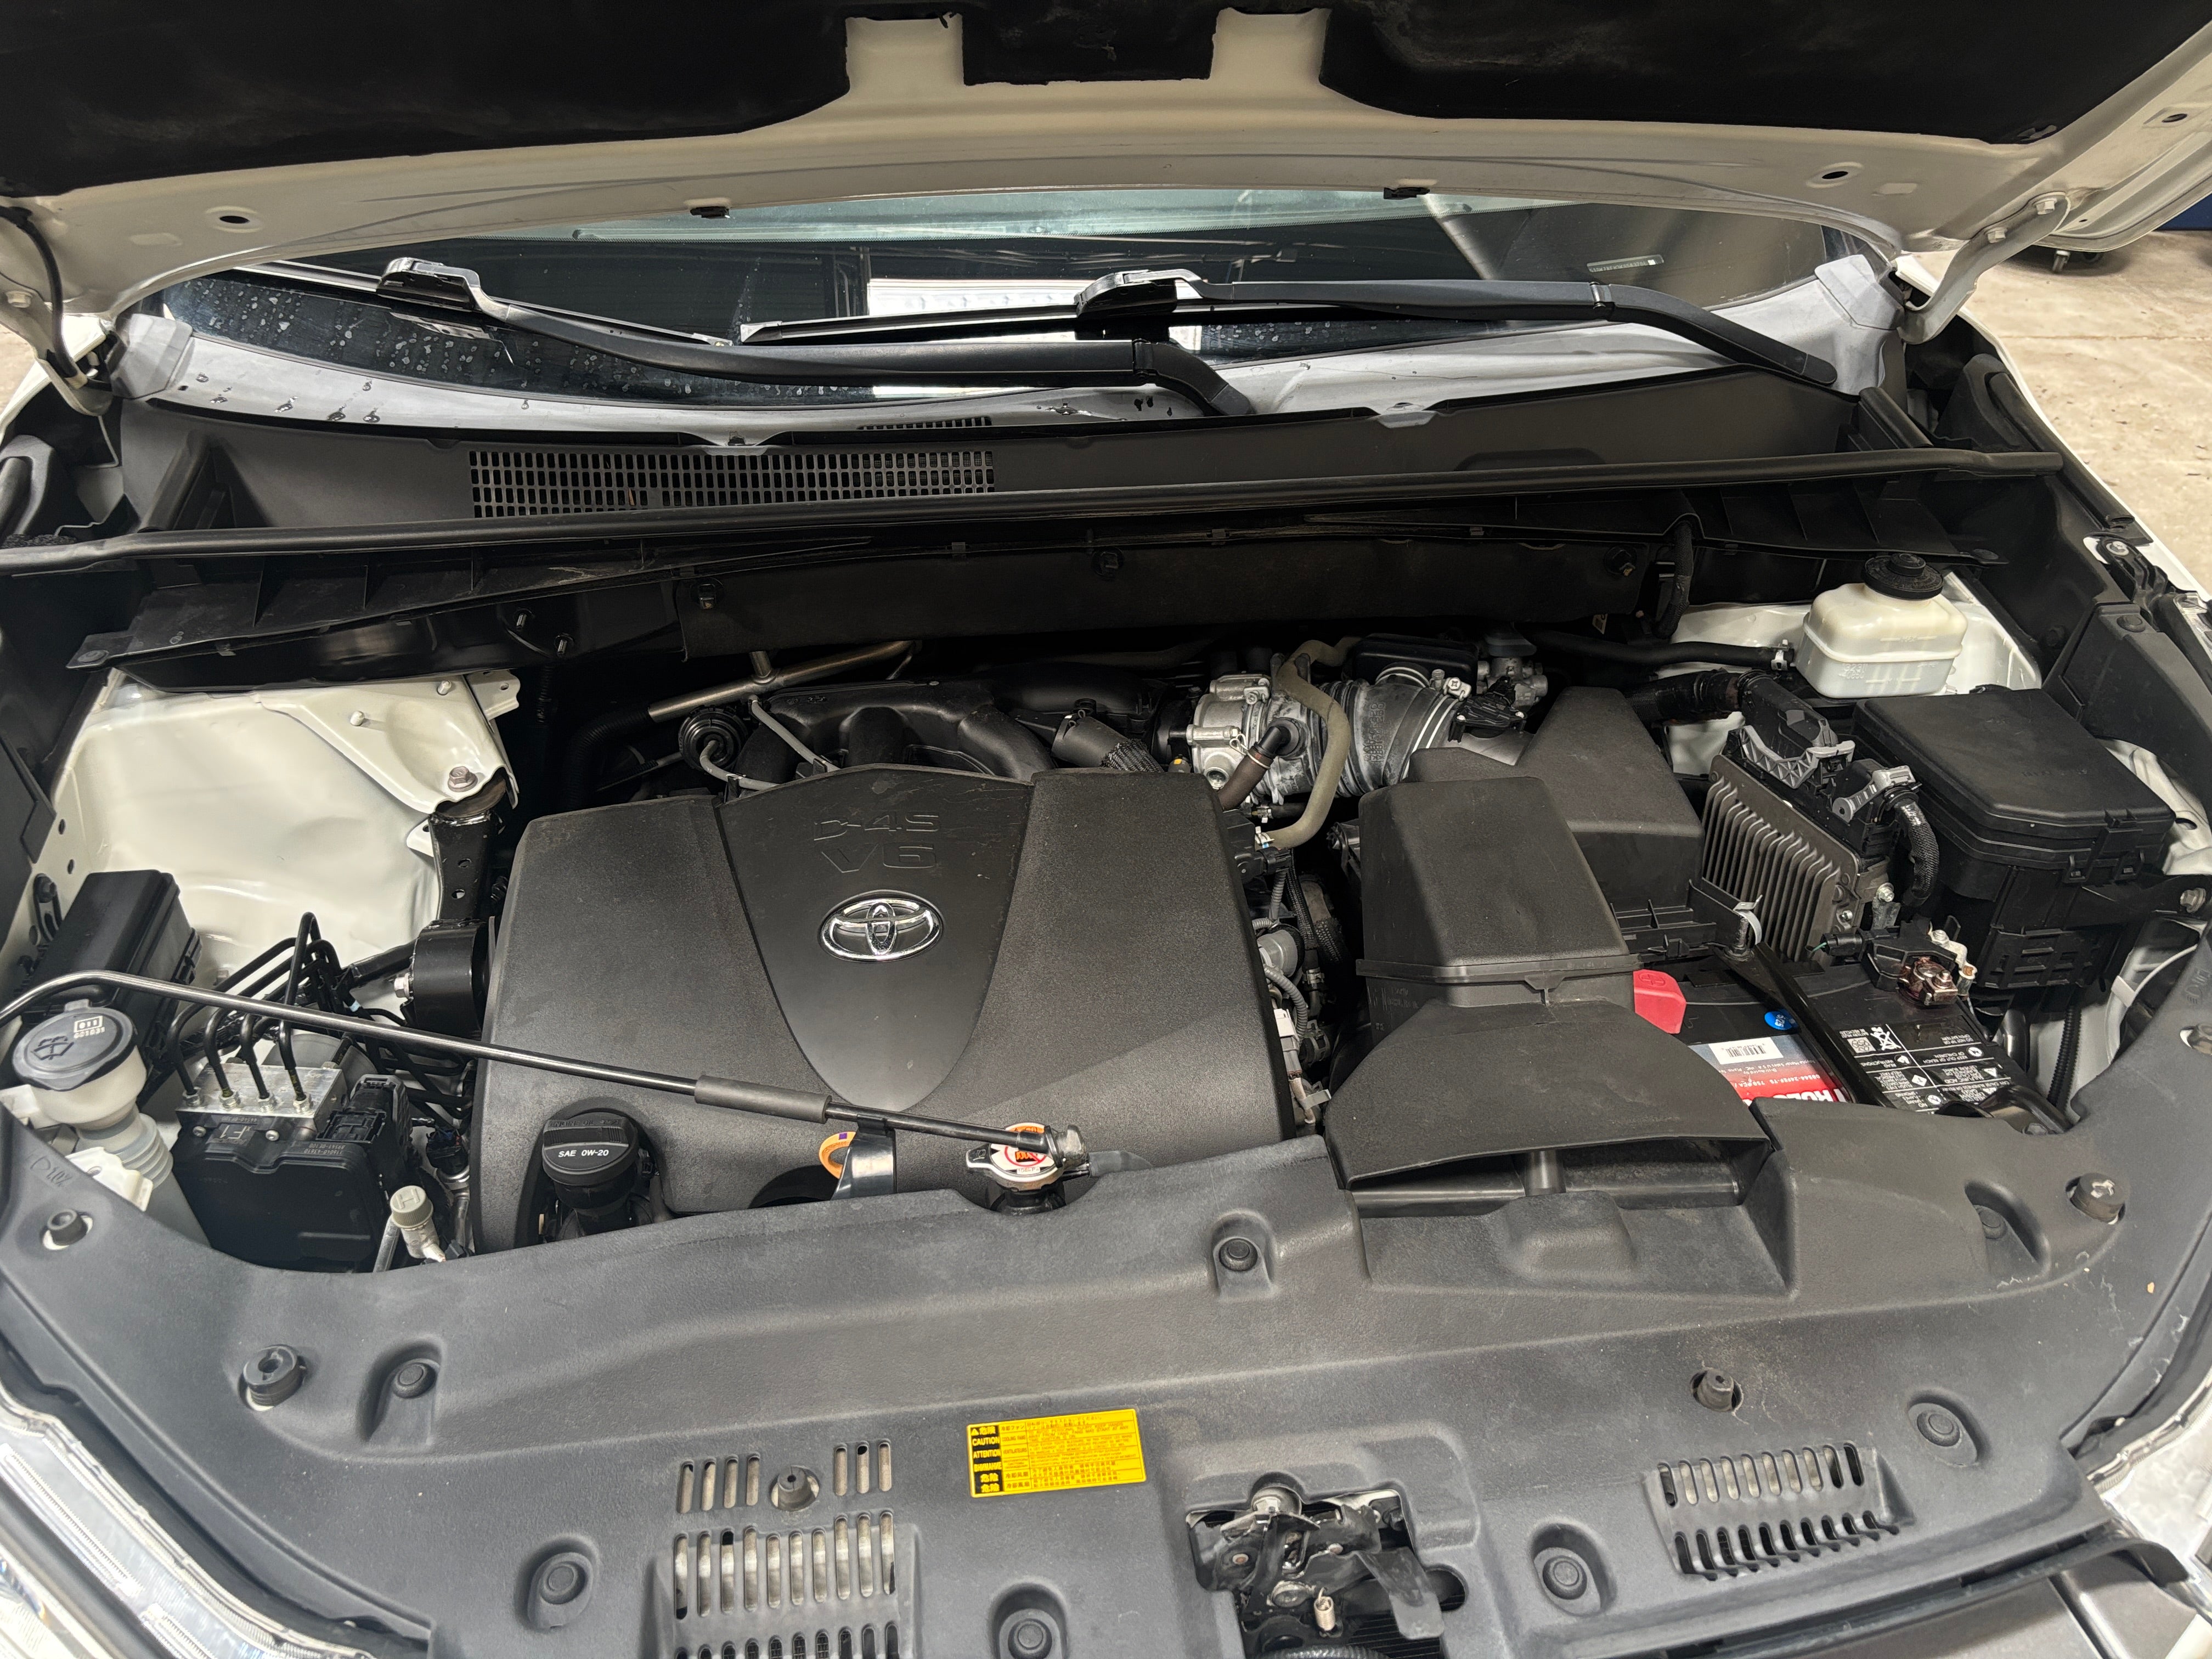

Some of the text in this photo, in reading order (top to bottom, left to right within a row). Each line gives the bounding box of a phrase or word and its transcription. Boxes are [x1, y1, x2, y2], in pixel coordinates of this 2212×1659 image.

[814, 812, 940, 841] D-4S
[821, 843, 937, 873] V6
[396, 1188, 420, 1209] H
[972, 1436, 1000, 1446] CAUTION
[973, 1449, 1001, 1459] ATTENTION
[973, 1461, 1002, 1472] ВНИМАНИЕ
